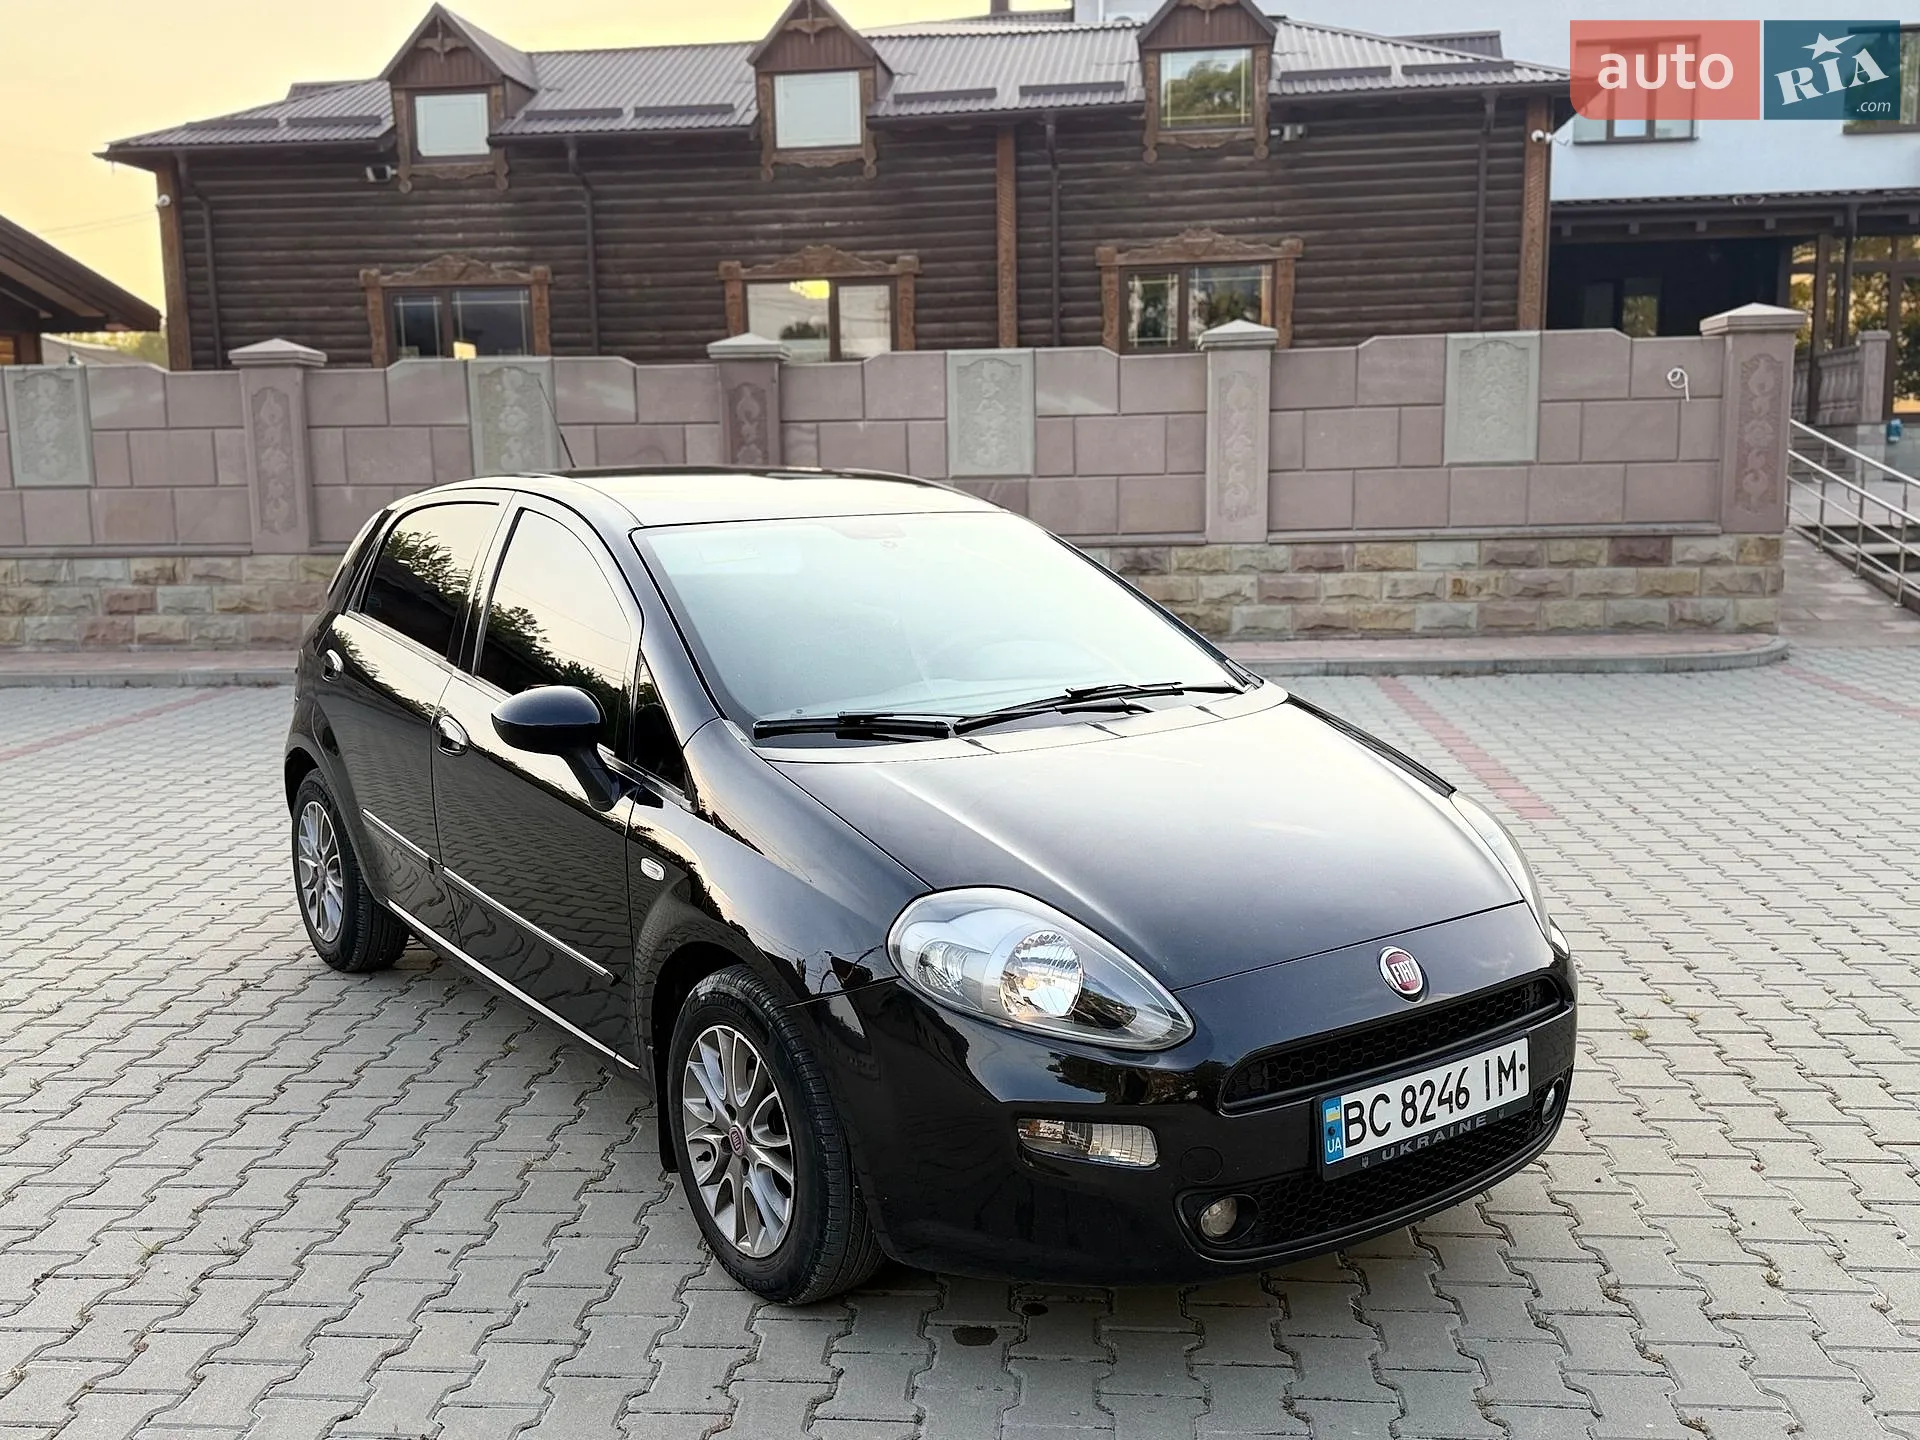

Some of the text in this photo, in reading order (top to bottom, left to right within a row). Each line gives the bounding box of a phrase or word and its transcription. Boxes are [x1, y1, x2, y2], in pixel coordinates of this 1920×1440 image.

[1389, 960, 1416, 985] FIAT
[1343, 1049, 1518, 1149] BC 8246 IM
[1326, 1136, 1342, 1154] UA
[1381, 1116, 1487, 1162] UKRAINE
